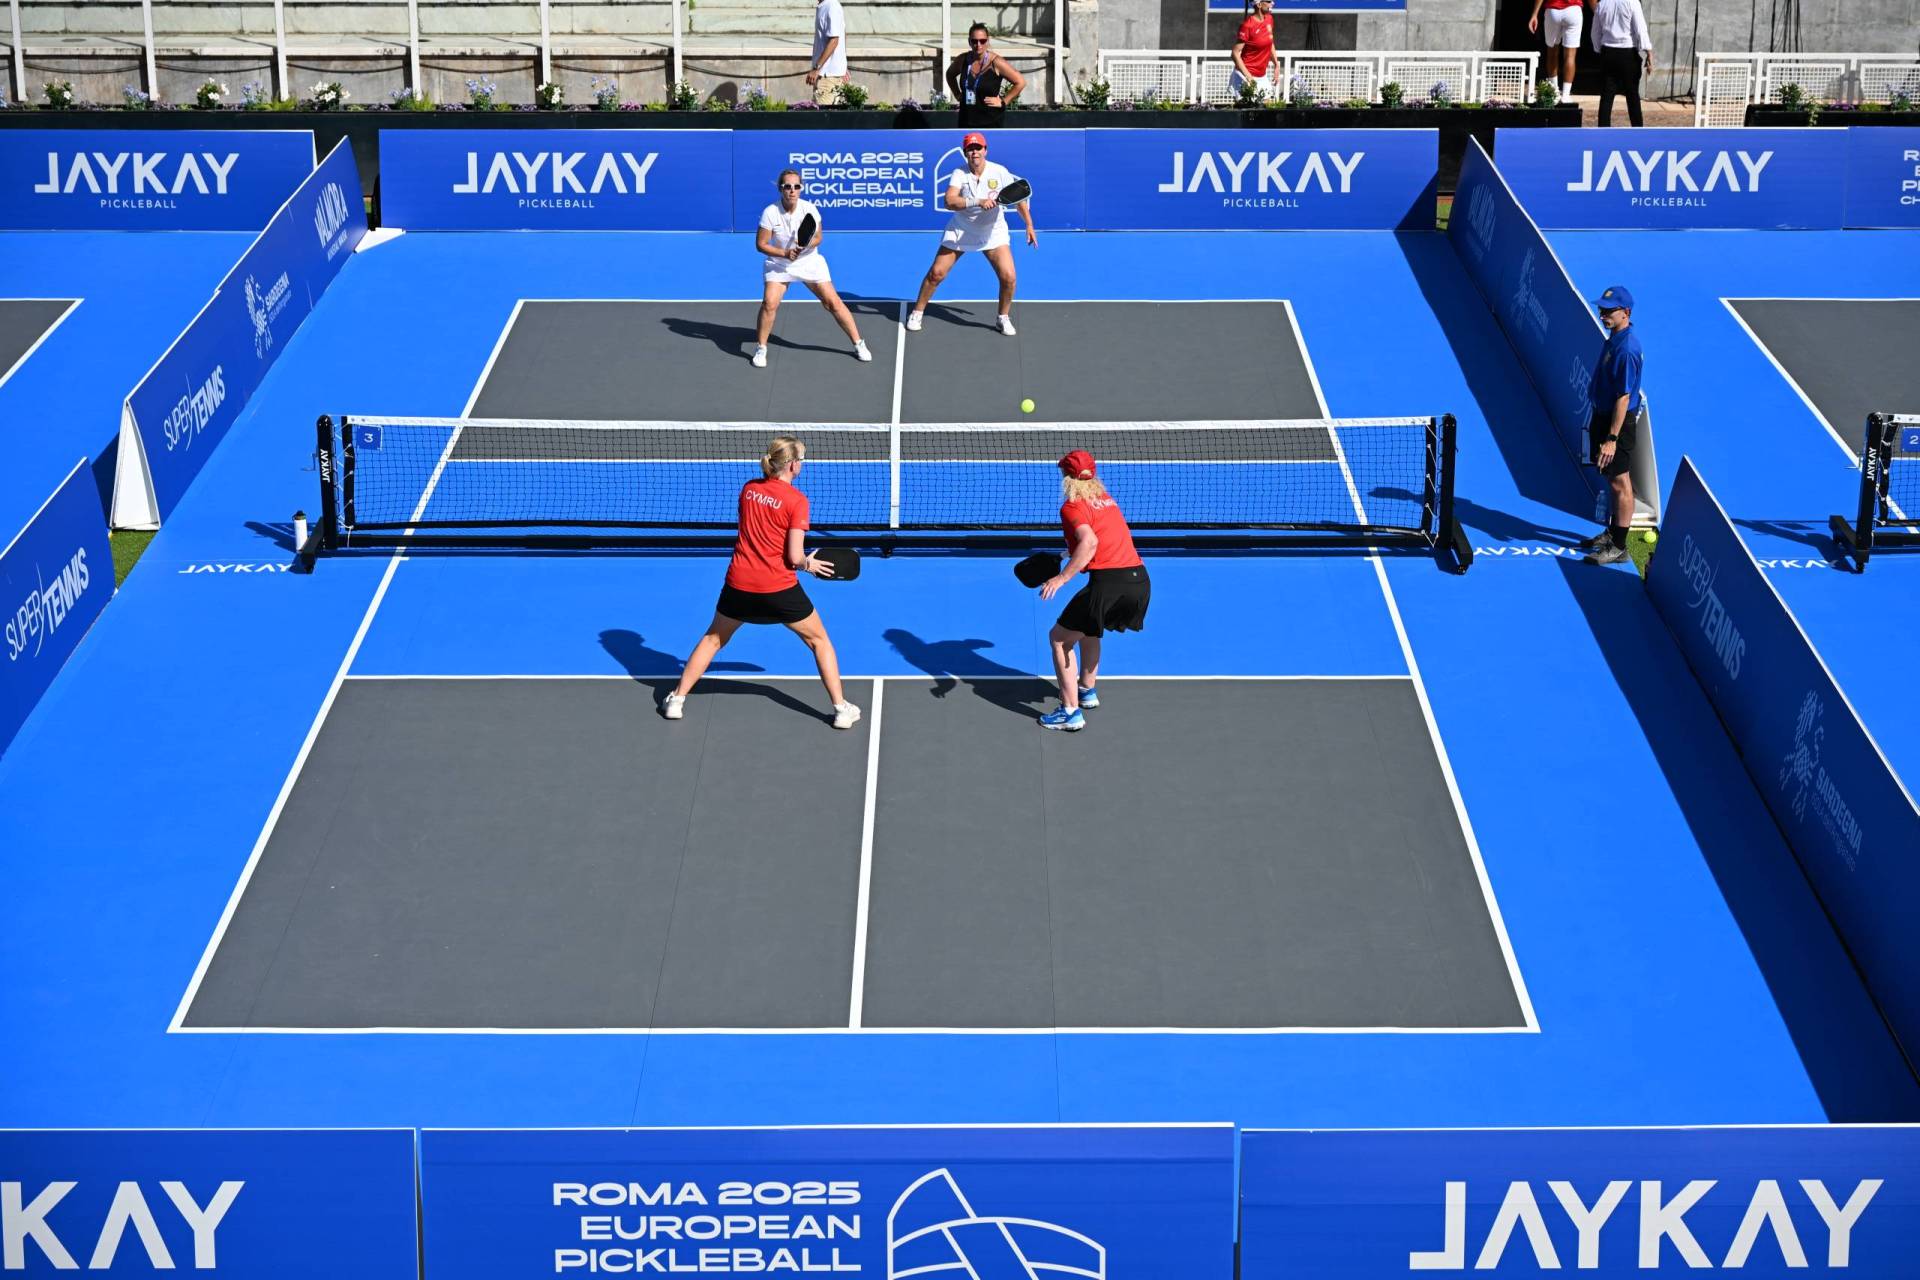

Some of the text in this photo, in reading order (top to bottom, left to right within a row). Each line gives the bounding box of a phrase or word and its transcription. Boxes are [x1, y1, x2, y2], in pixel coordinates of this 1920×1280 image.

[789, 152, 924, 164] ROMA 2025
[1567, 150, 1774, 192] JAYKAY
[34, 152, 240, 194] JAYKAY
[453, 152, 659, 194] JAYKAY
[801, 167, 923, 180] EUROPEAN
[1158, 151, 1365, 193] JAYKAY
[100, 199, 177, 209] PICKLEBALL
[519, 199, 595, 208] PICKLEBALL
[1223, 198, 1299, 208] PICKLEBALL
[1631, 197, 1707, 207] PICKLEBALL
[163, 364, 226, 452] SUPER TENNIS
[364, 433, 374, 443] 3
[1909, 435, 1919, 444] 2
[320, 448, 330, 483] JAYKAY
[1866, 447, 1877, 481] JAYKAY
[745, 490, 782, 510] CYMRU
[178, 563, 295, 574] JAYKAY
[6, 546, 89, 661] SUPER TENNIS
[1678, 534, 1746, 681] SUPER TENNIS
[552, 1181, 861, 1206] ROMA 2025
[580, 1214, 861, 1240] EUROPEAN
[1409, 1179, 1885, 1270] JAYKAY
[555, 1247, 862, 1273] PICKLEBALL
